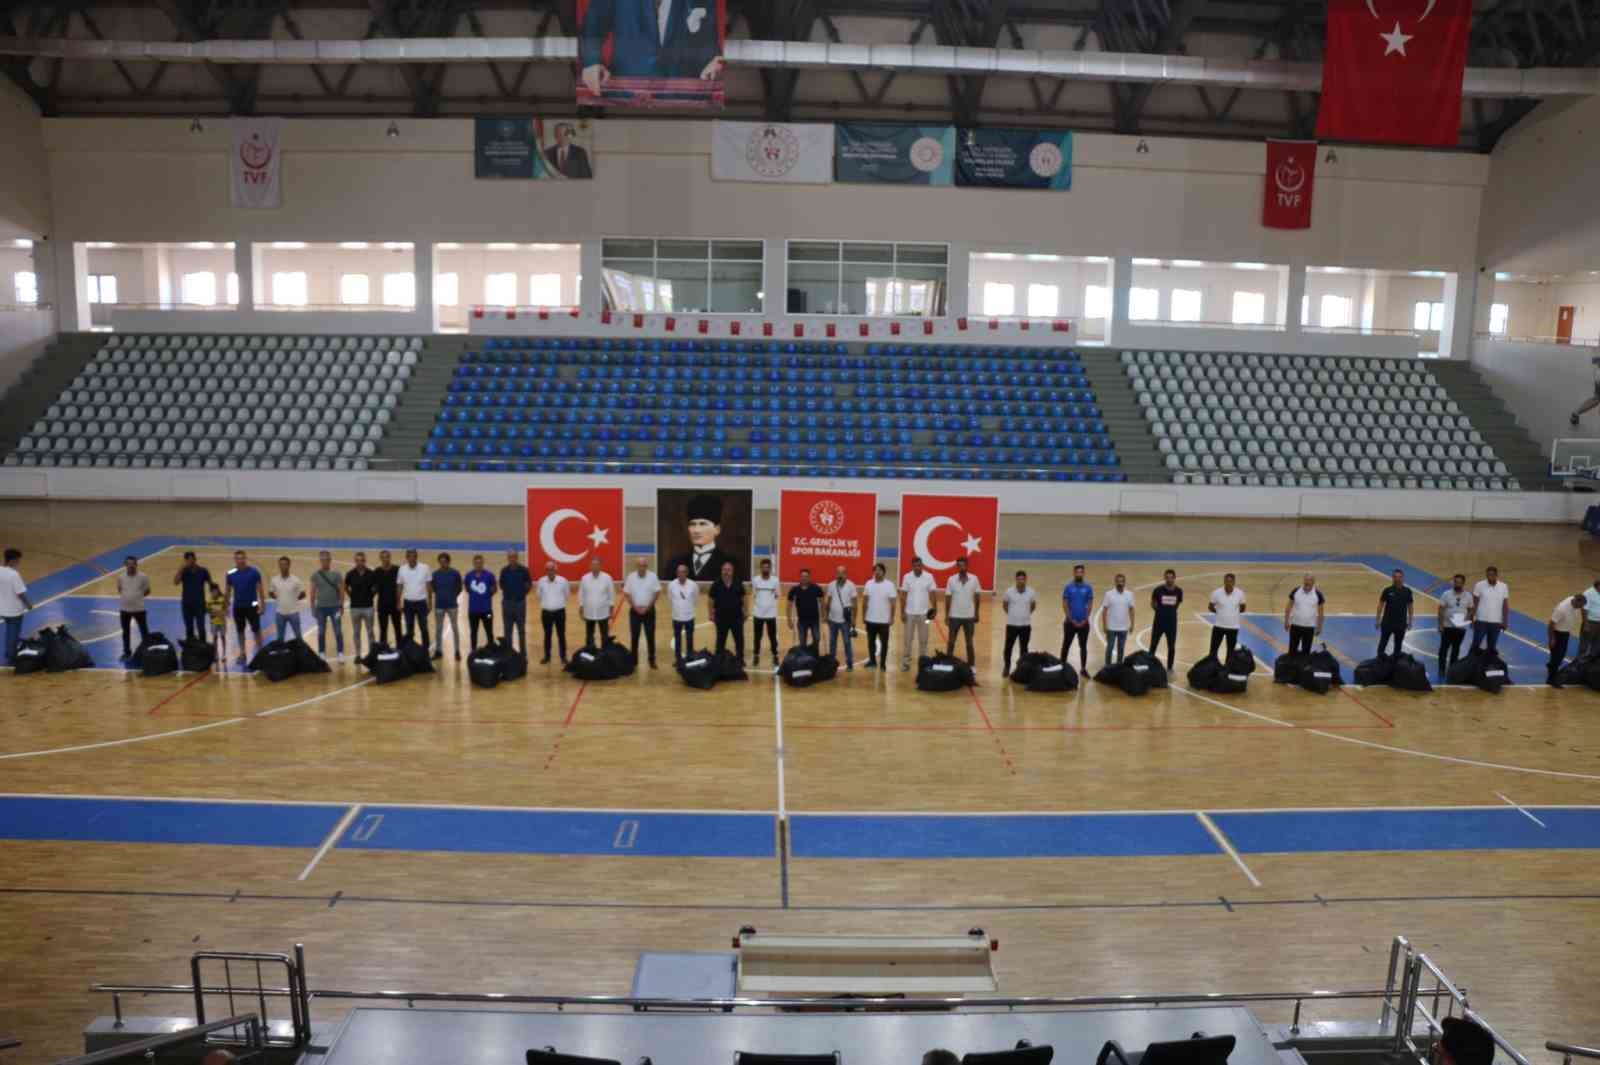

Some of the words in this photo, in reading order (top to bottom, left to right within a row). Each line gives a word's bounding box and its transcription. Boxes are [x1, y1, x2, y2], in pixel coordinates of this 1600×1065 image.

[243, 171, 268, 185] TVF
[1277, 193, 1301, 207] TVF
[794, 537, 809, 545] T.C.
[847, 539, 858, 547] VE
[791, 547, 813, 555] SPOR
